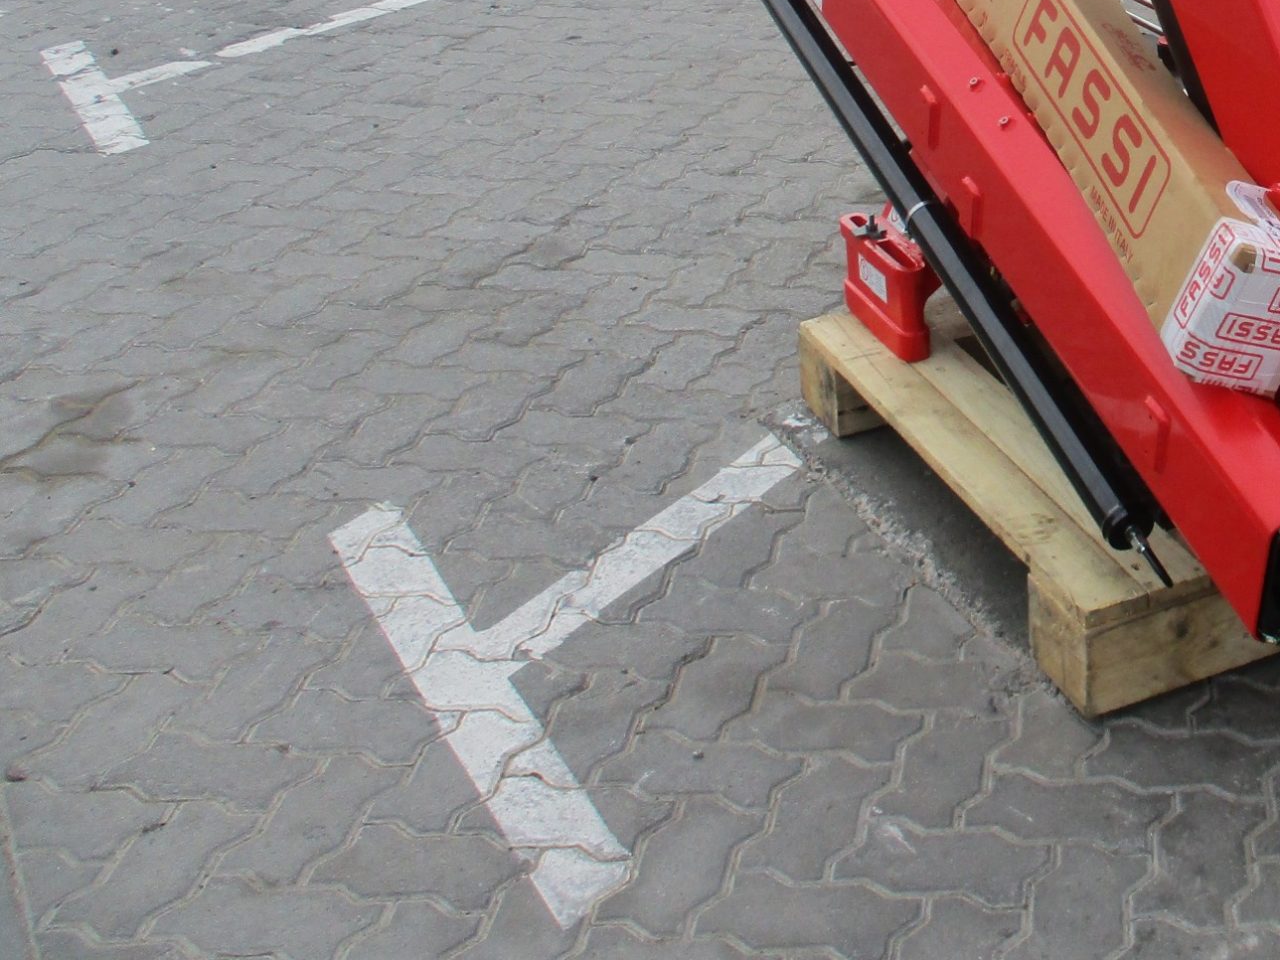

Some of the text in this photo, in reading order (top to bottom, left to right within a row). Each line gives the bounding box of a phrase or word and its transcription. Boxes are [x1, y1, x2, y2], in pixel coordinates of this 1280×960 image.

[1090, 185, 1134, 264] MADE IN ITALY
[1179, 234, 1227, 318] FASSI
